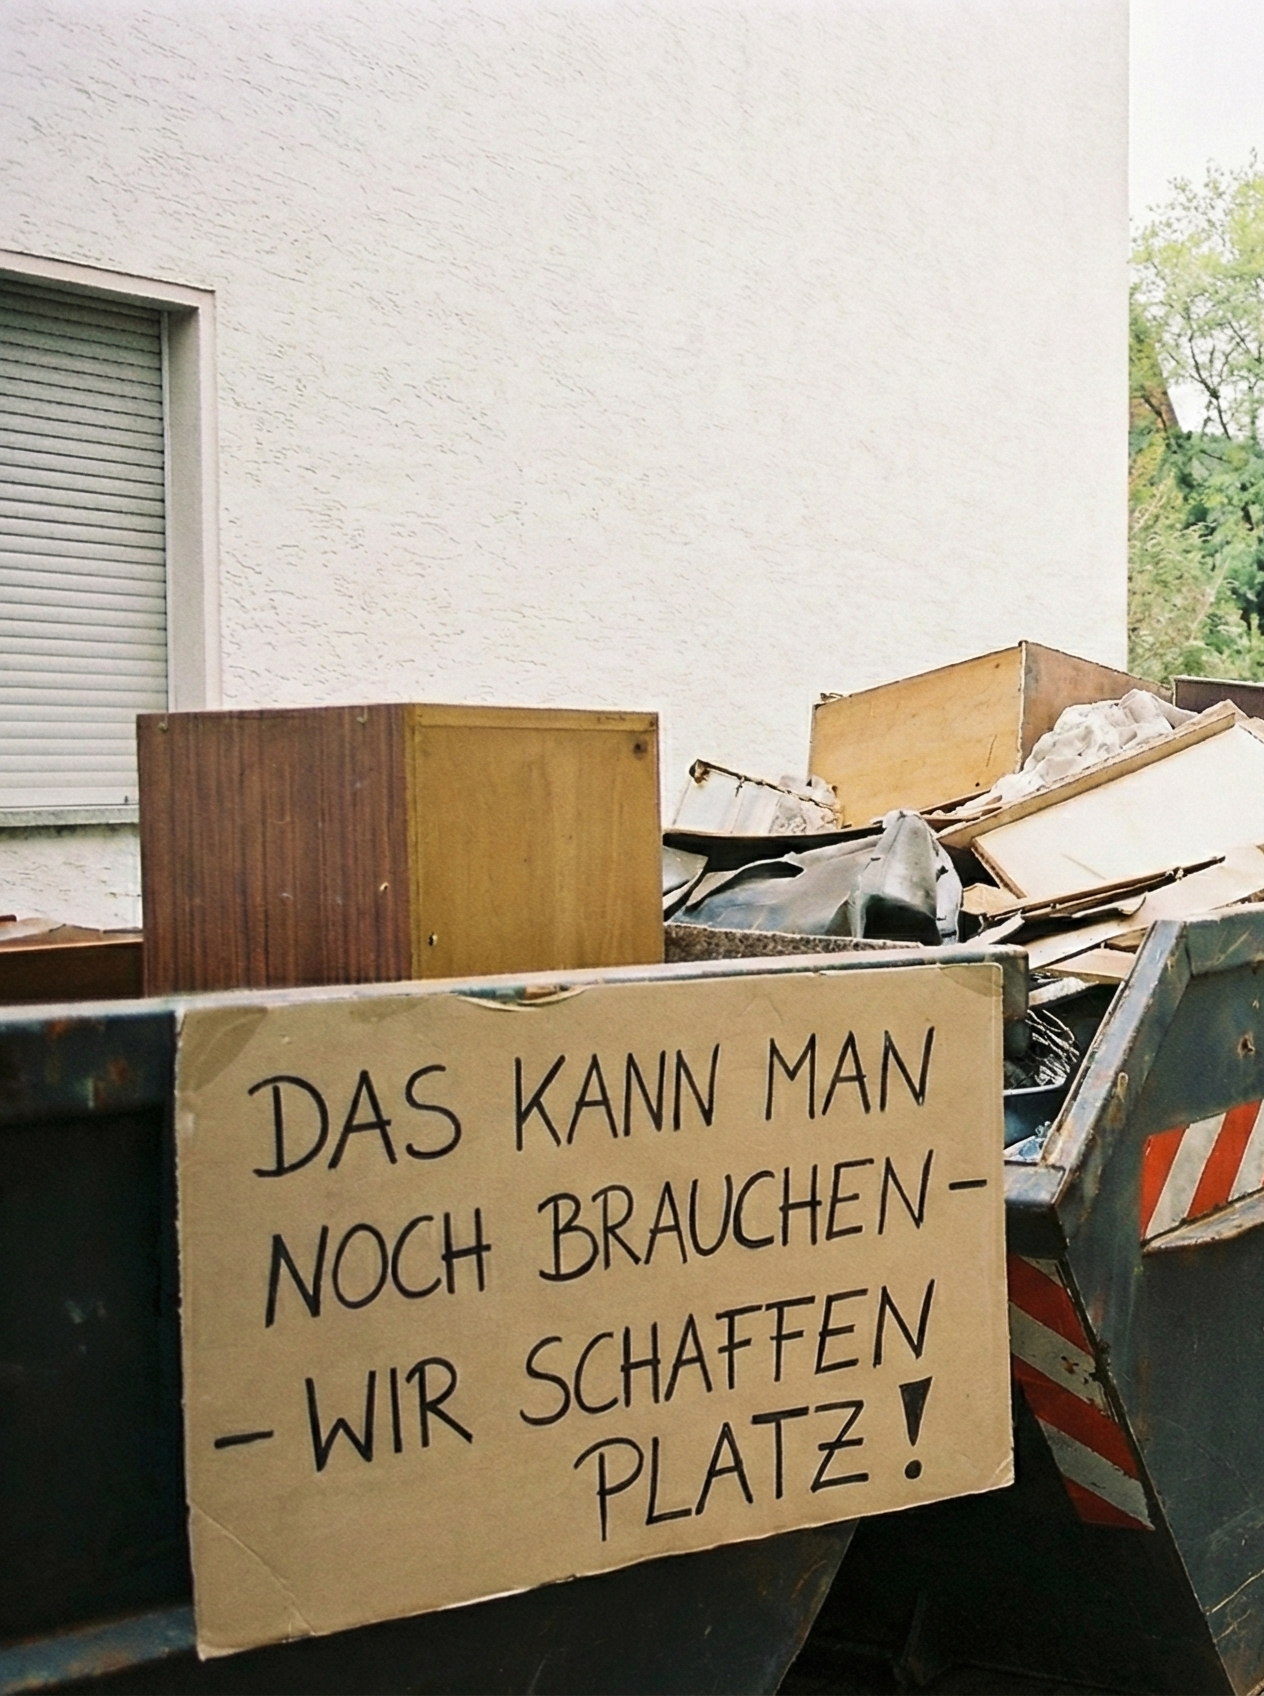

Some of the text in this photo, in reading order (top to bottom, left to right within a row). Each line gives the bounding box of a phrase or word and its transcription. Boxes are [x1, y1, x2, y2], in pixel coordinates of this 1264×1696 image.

[246, 1025, 936, 1179] DAS KANN MAN
[263, 1148, 989, 1330] NOCH BRAUCHEN-
[518, 1277, 936, 1428] SCHAFFEN
